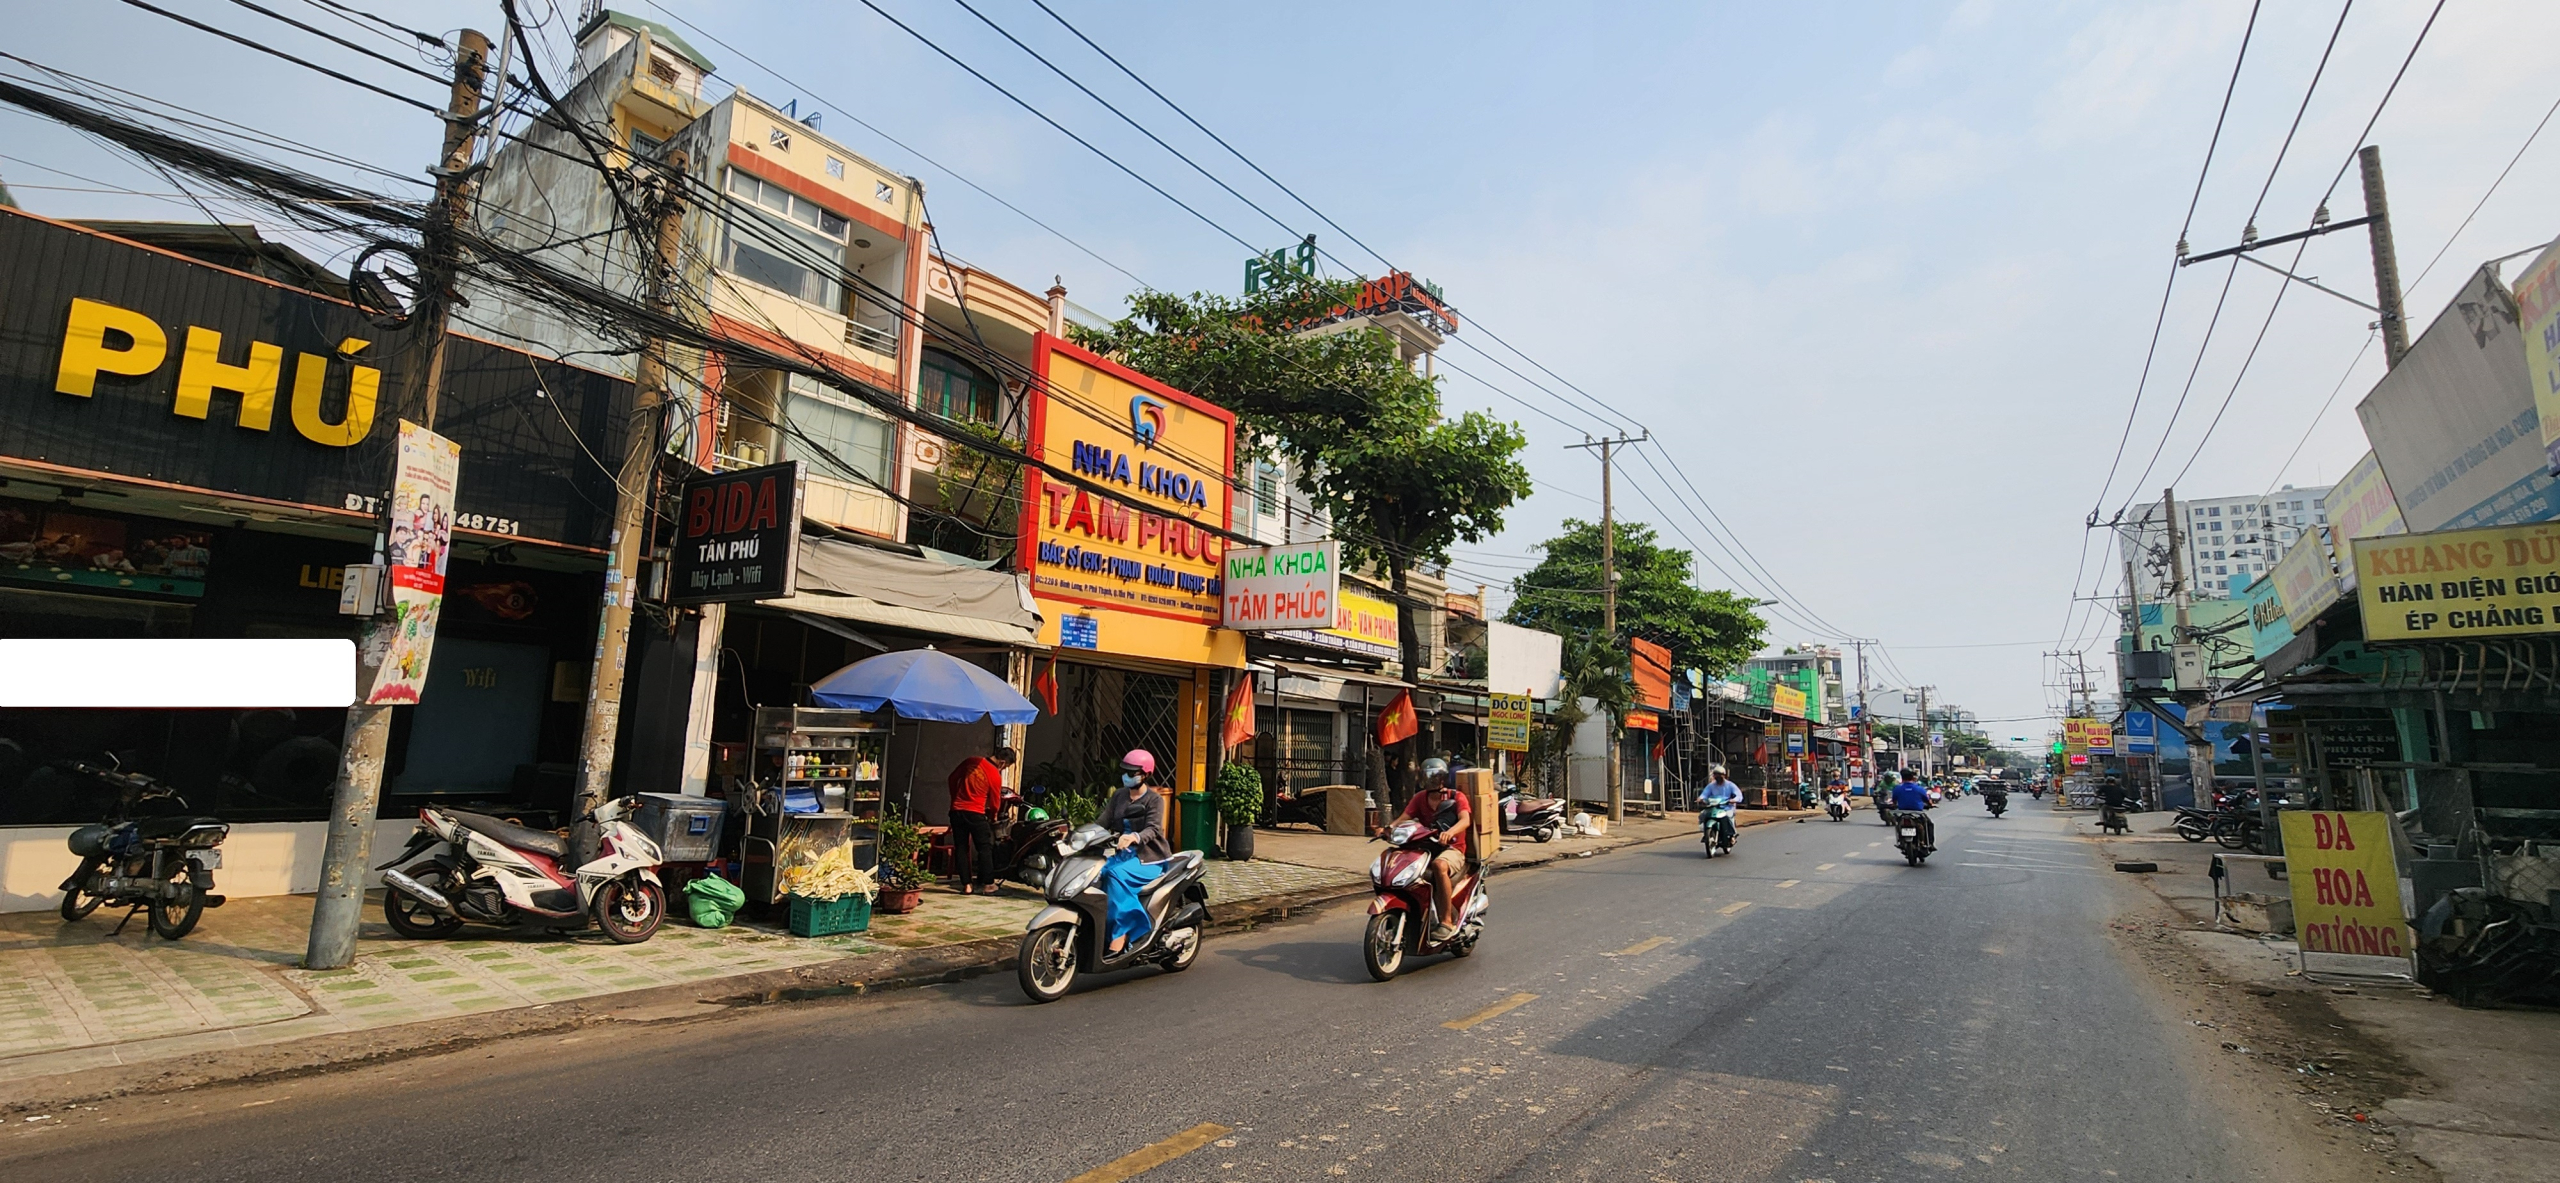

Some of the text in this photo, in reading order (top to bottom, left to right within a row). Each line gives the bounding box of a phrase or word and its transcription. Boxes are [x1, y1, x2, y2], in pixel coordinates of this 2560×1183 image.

[55, 297, 382, 447] PHÚ
[1073, 440, 1207, 508] NHA KHOA
[687, 476, 777, 538] BIDA
[699, 534, 760, 563] TÂN PHÚ
[1138, 511, 1220, 565] PHÚC
[1038, 539, 1065, 565] BÁC
[1108, 556, 1141, 584] PHẠM
[1229, 551, 1327, 580] NHA KHOA
[2369, 541, 2495, 577] KHANG
[690, 570, 709, 589] Máy
[711, 567, 733, 590] Lạnh
[742, 565, 761, 584] Wifi
[2379, 571, 2560, 603] HÀN ĐIỆN GIÓ
[1229, 580, 1326, 622] TÂM PHÚC
[2405, 609, 2438, 631] ÉP
[2448, 603, 2544, 629] CHẢNG
[1374, 614, 1397, 641] PHÒNG
[463, 667, 497, 690] Wifi
[1492, 696, 1527, 711] ĐỒ CŨ
[1510, 711, 1526, 720] LONG
[2312, 868, 2375, 907] HOA
